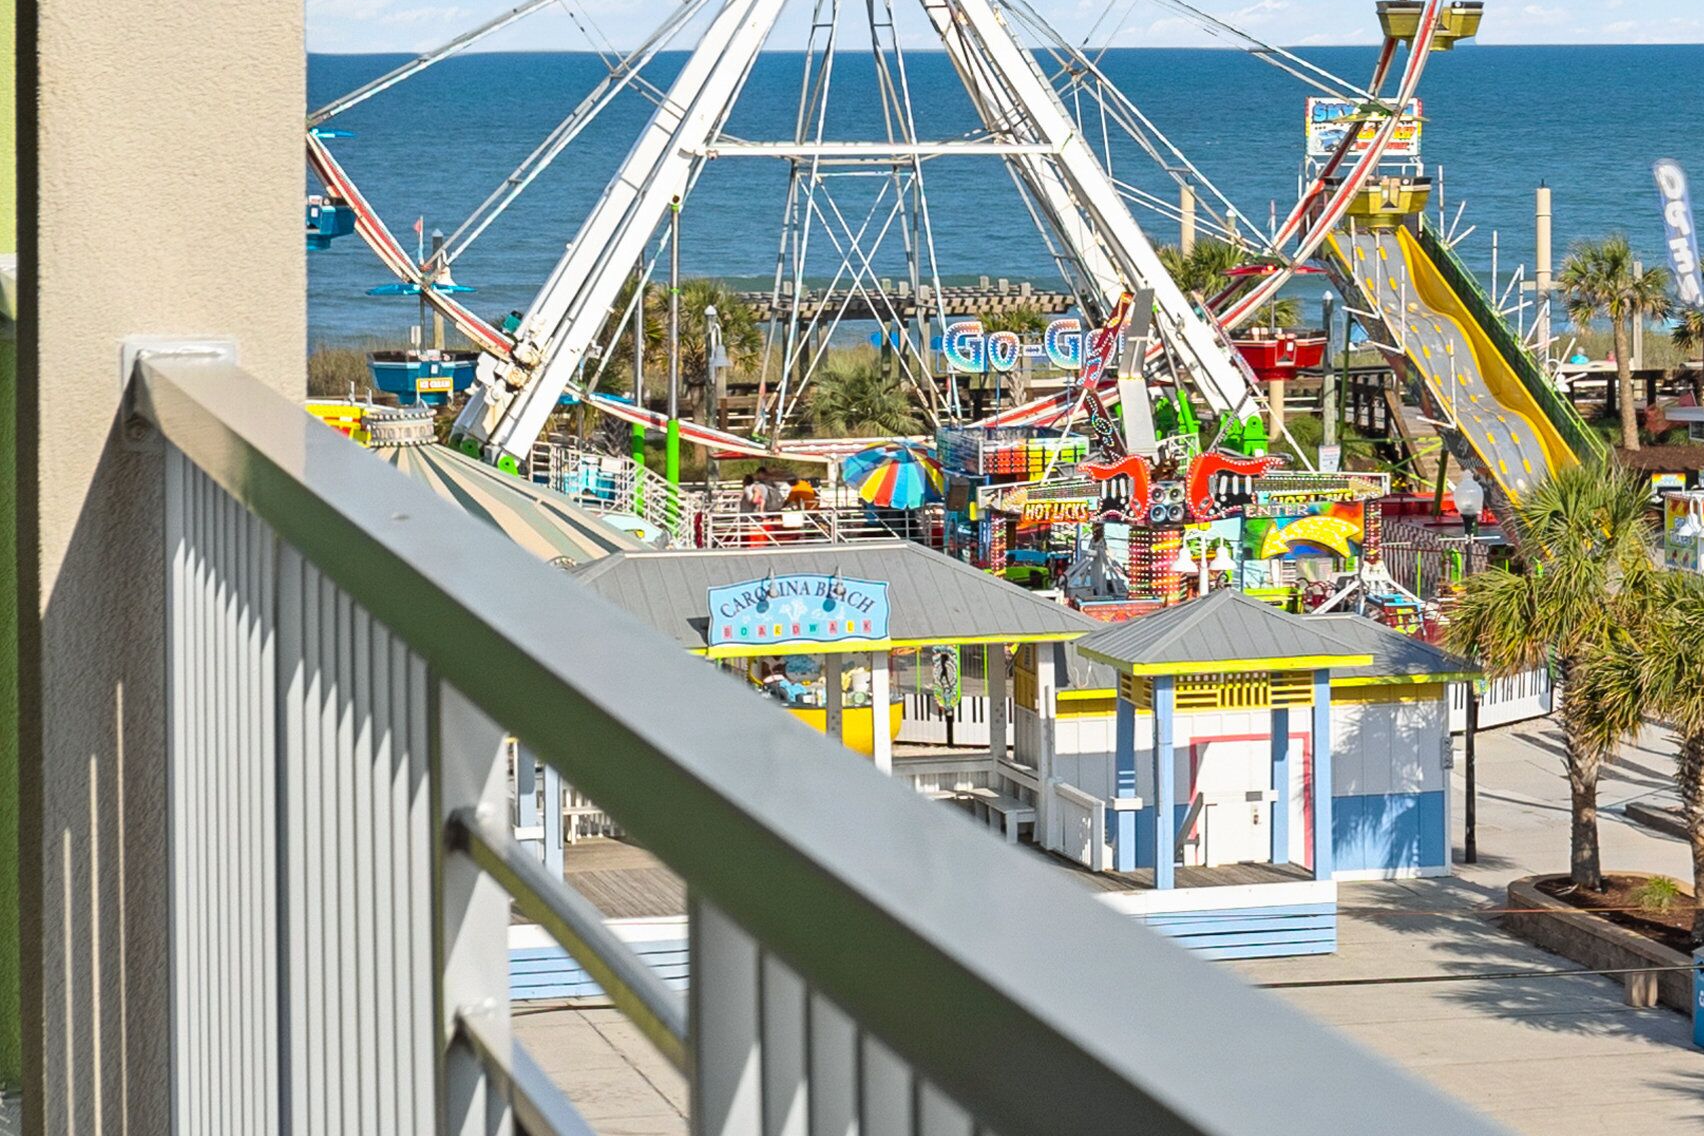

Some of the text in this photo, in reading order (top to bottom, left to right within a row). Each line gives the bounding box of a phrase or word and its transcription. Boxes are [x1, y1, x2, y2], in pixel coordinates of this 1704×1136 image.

[1024, 502, 1088, 520] HOT LICKS
[1245, 504, 1309, 517] ENTER
[723, 620, 872, 638] BOARDWALK
